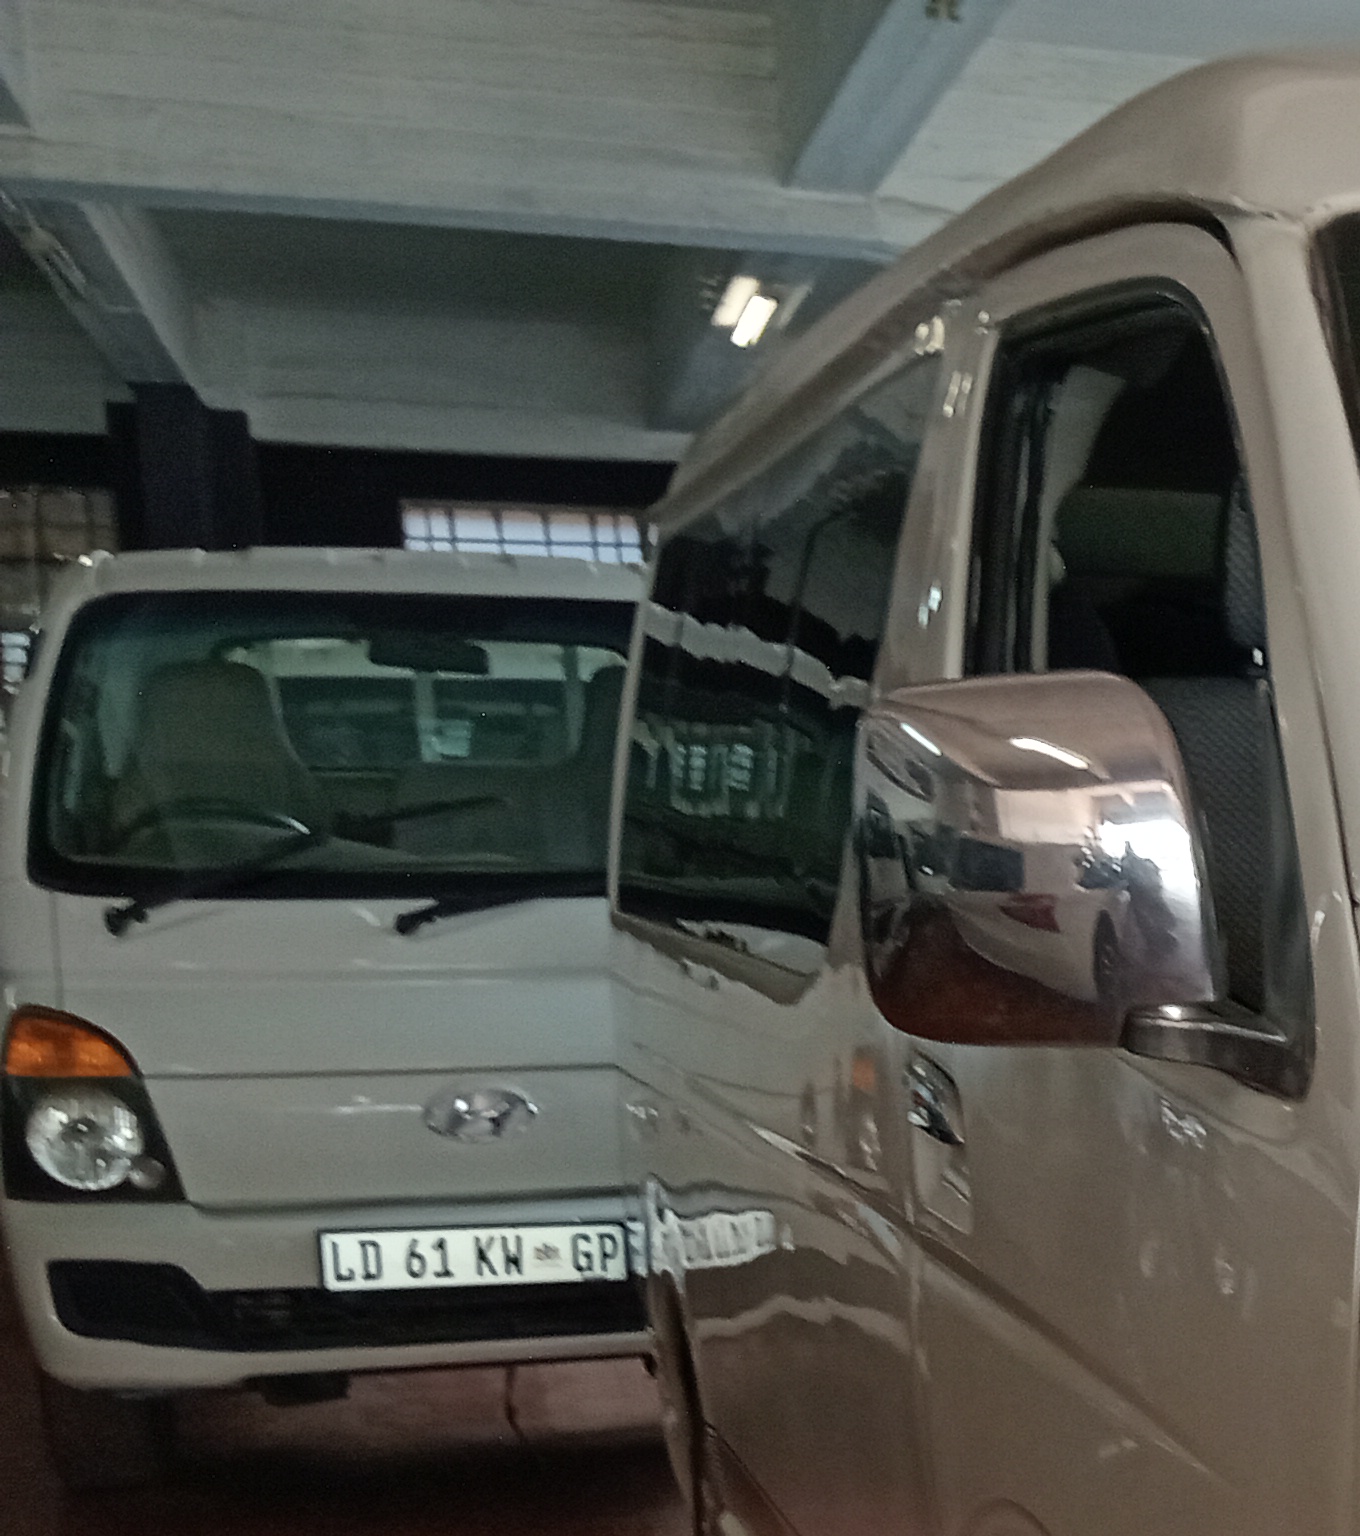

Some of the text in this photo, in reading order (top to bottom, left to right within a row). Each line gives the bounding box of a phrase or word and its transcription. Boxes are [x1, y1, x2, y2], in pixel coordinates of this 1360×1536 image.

[331, 1232, 619, 1282] LD 61 KW GP
